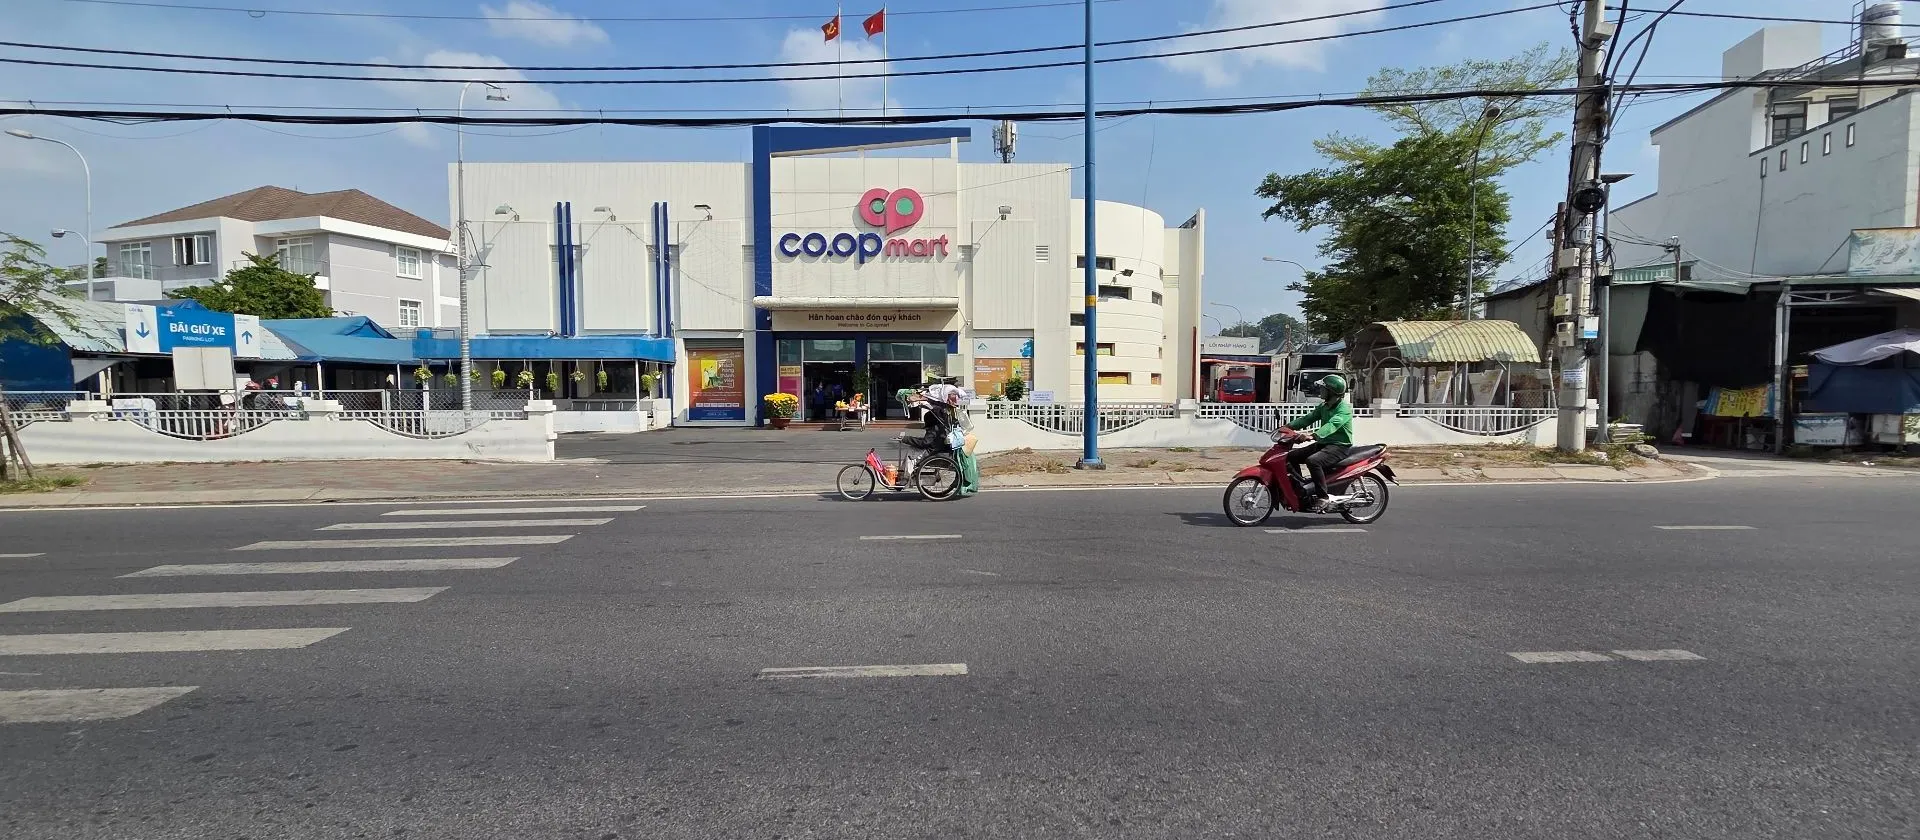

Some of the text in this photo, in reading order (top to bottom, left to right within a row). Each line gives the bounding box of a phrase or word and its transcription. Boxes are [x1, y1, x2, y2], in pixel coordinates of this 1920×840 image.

[825, 313, 845, 321] hoan
[846, 312, 865, 321] chào
[866, 312, 881, 321] đón
[882, 312, 897, 322] quý
[898, 313, 921, 321] khách
[169, 321, 226, 336] BÃI GIỮ XE
